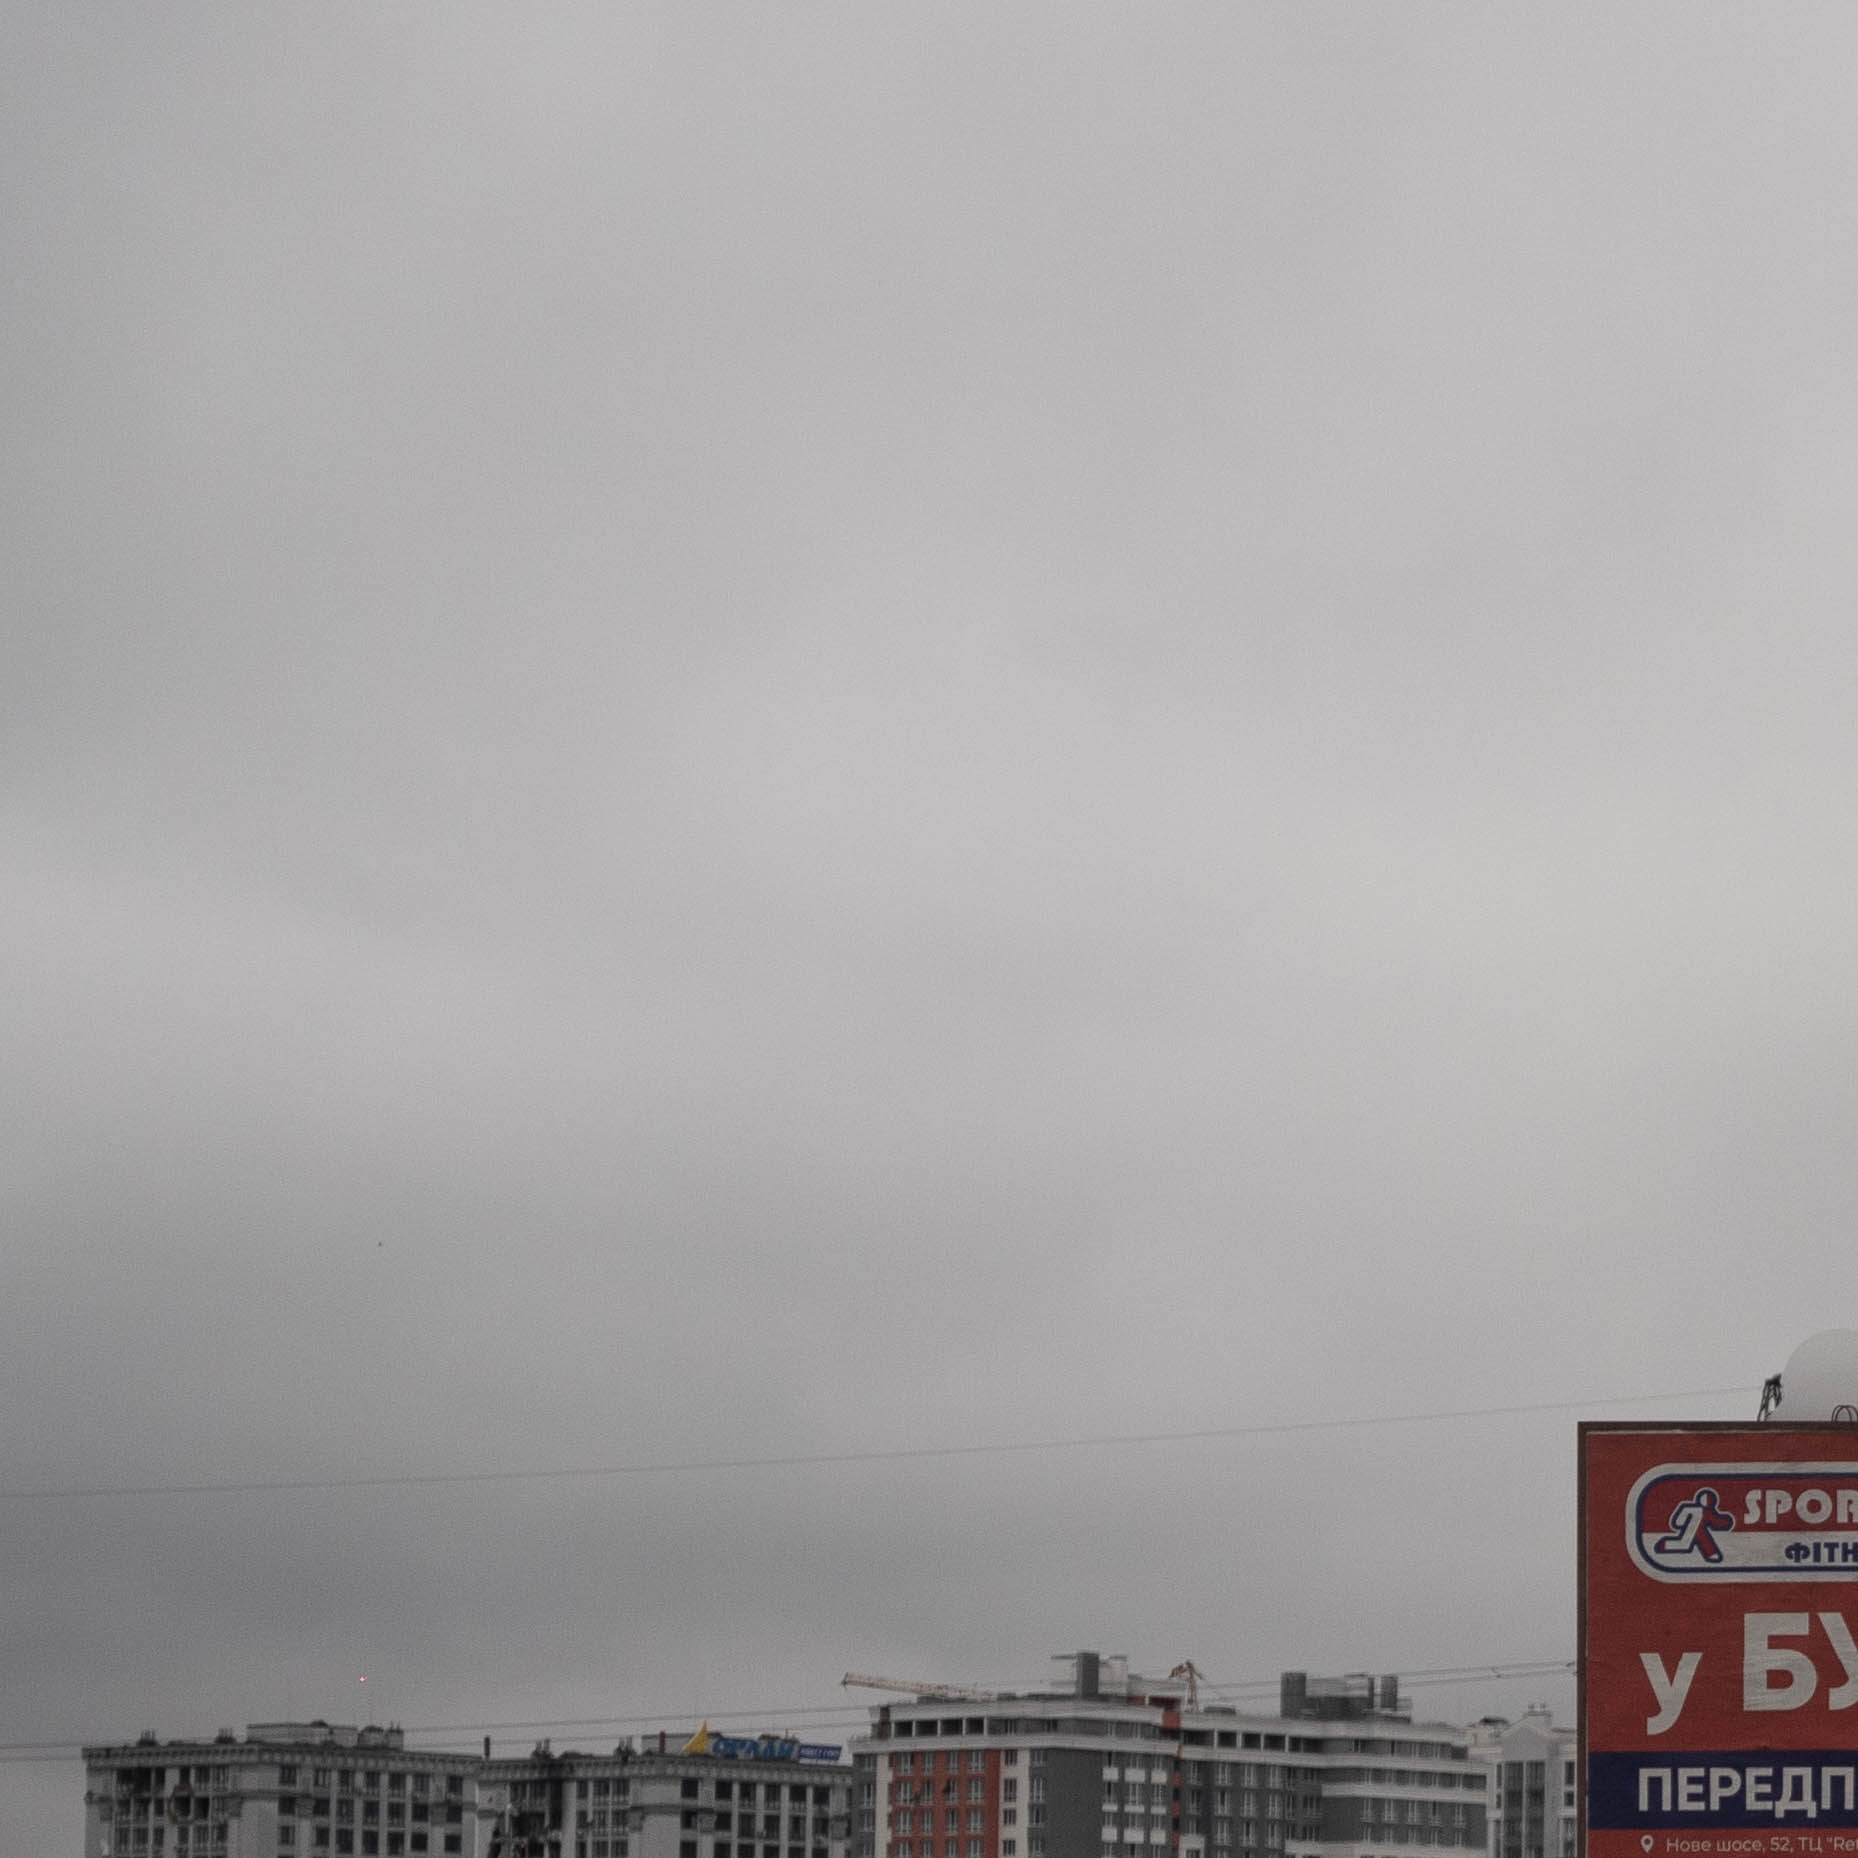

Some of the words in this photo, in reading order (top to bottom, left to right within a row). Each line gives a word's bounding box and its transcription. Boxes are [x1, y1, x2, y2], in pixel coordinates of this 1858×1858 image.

[1639, 1652, 1703, 1735] у
[1666, 1837, 1711, 1853] Нове
[1716, 1839, 1765, 1854] шосе,
[1770, 1837, 1794, 1854] 52,
[1798, 1837, 1823, 1854] ТЦ
